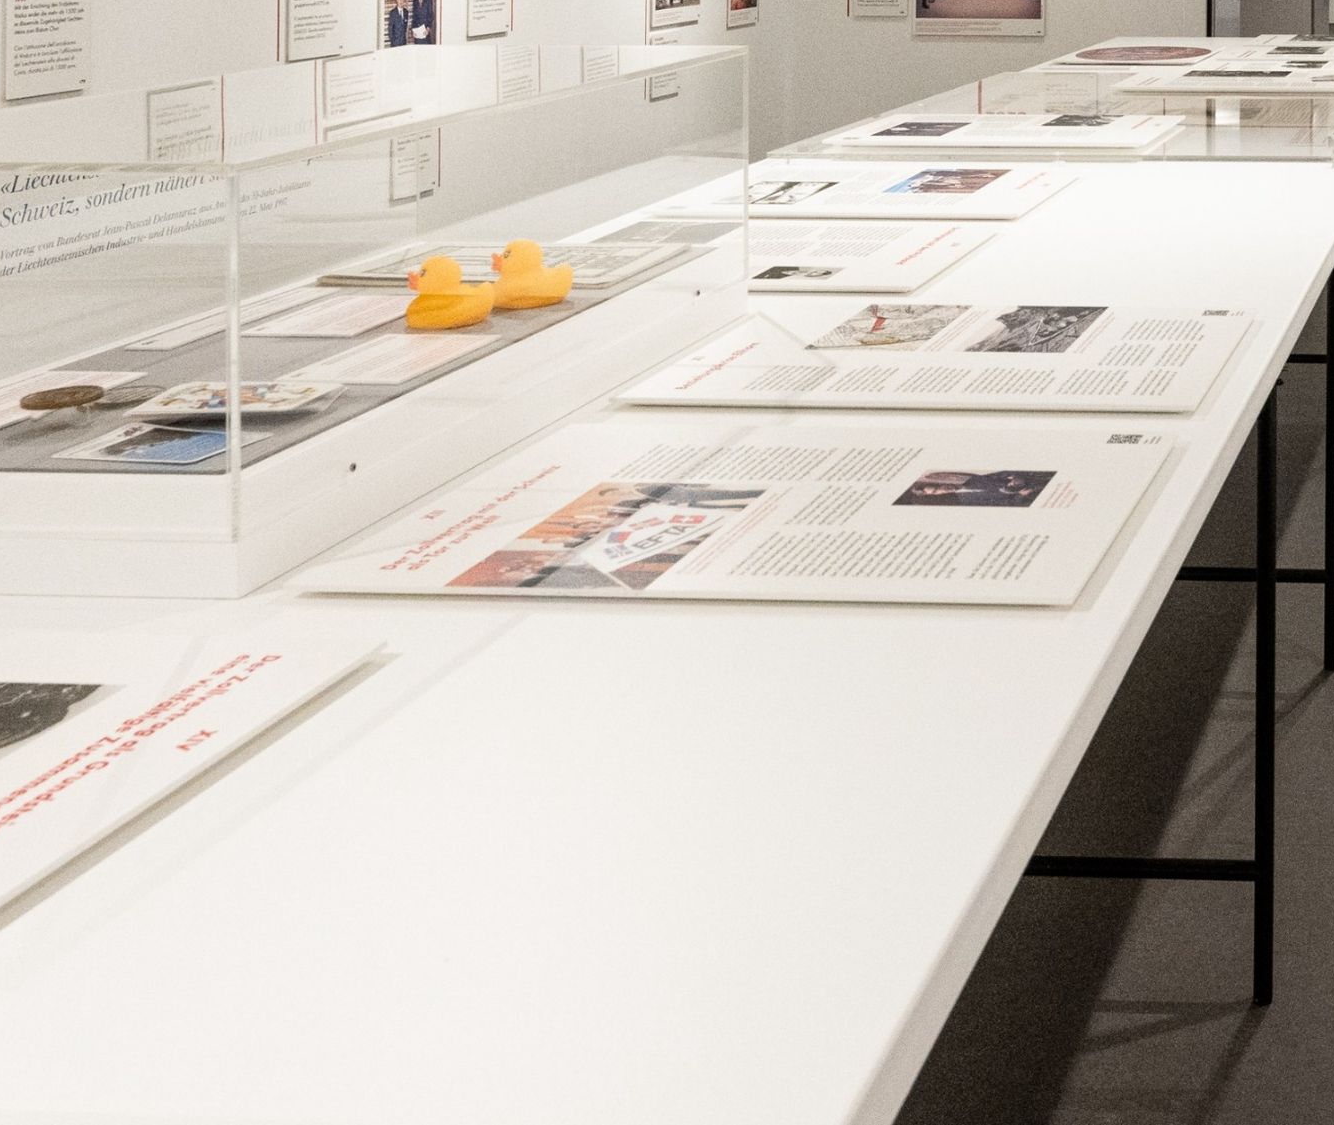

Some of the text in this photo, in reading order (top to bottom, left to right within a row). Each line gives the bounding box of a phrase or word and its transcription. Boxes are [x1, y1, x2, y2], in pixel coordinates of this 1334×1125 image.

[0, 198, 80, 228] Schweiz,
[85, 183, 152, 210] sondern
[0, 242, 35, 261] Vortrag
[56, 228, 102, 247] Bundesrat
[103, 218, 152, 237] Jean-Pascal
[0, 266, 15, 277] der
[17, 244, 104, 274] Liechtensteinischen
[105, 235, 147, 252] Industrie-
[379, 557, 409, 570] Der
[405, 514, 484, 555] Zollvertrag
[631, 525, 687, 550] EFTA
[245, 654, 283, 674] Der
[134, 674, 251, 738] Zollvertrag
